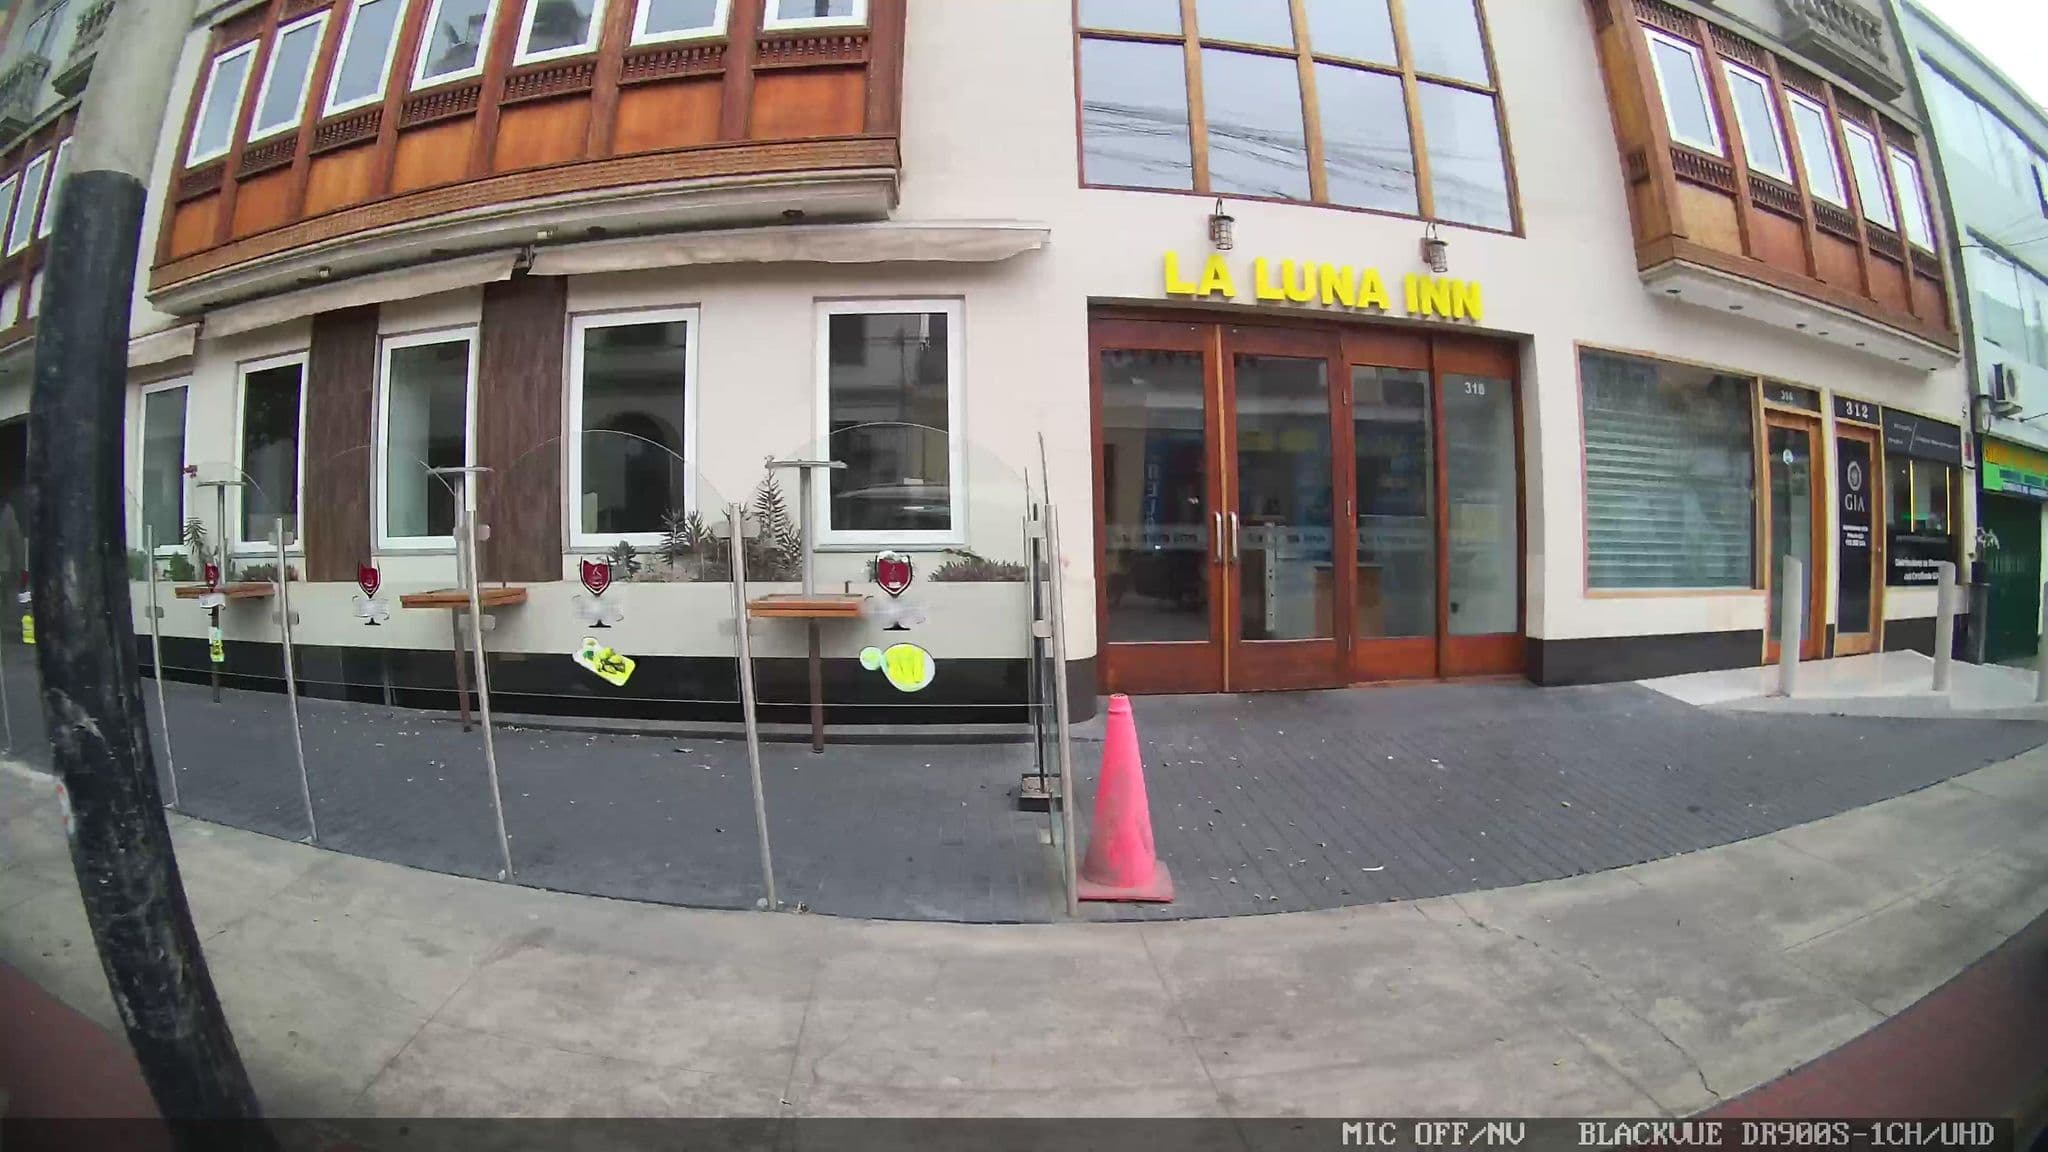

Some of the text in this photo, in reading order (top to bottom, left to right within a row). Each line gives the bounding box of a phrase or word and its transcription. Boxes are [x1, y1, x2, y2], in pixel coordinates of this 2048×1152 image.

[1164, 250, 1484, 322] LA LUNA INN
[1846, 401, 1869, 419] 312
[1845, 493, 1865, 513] GIA
